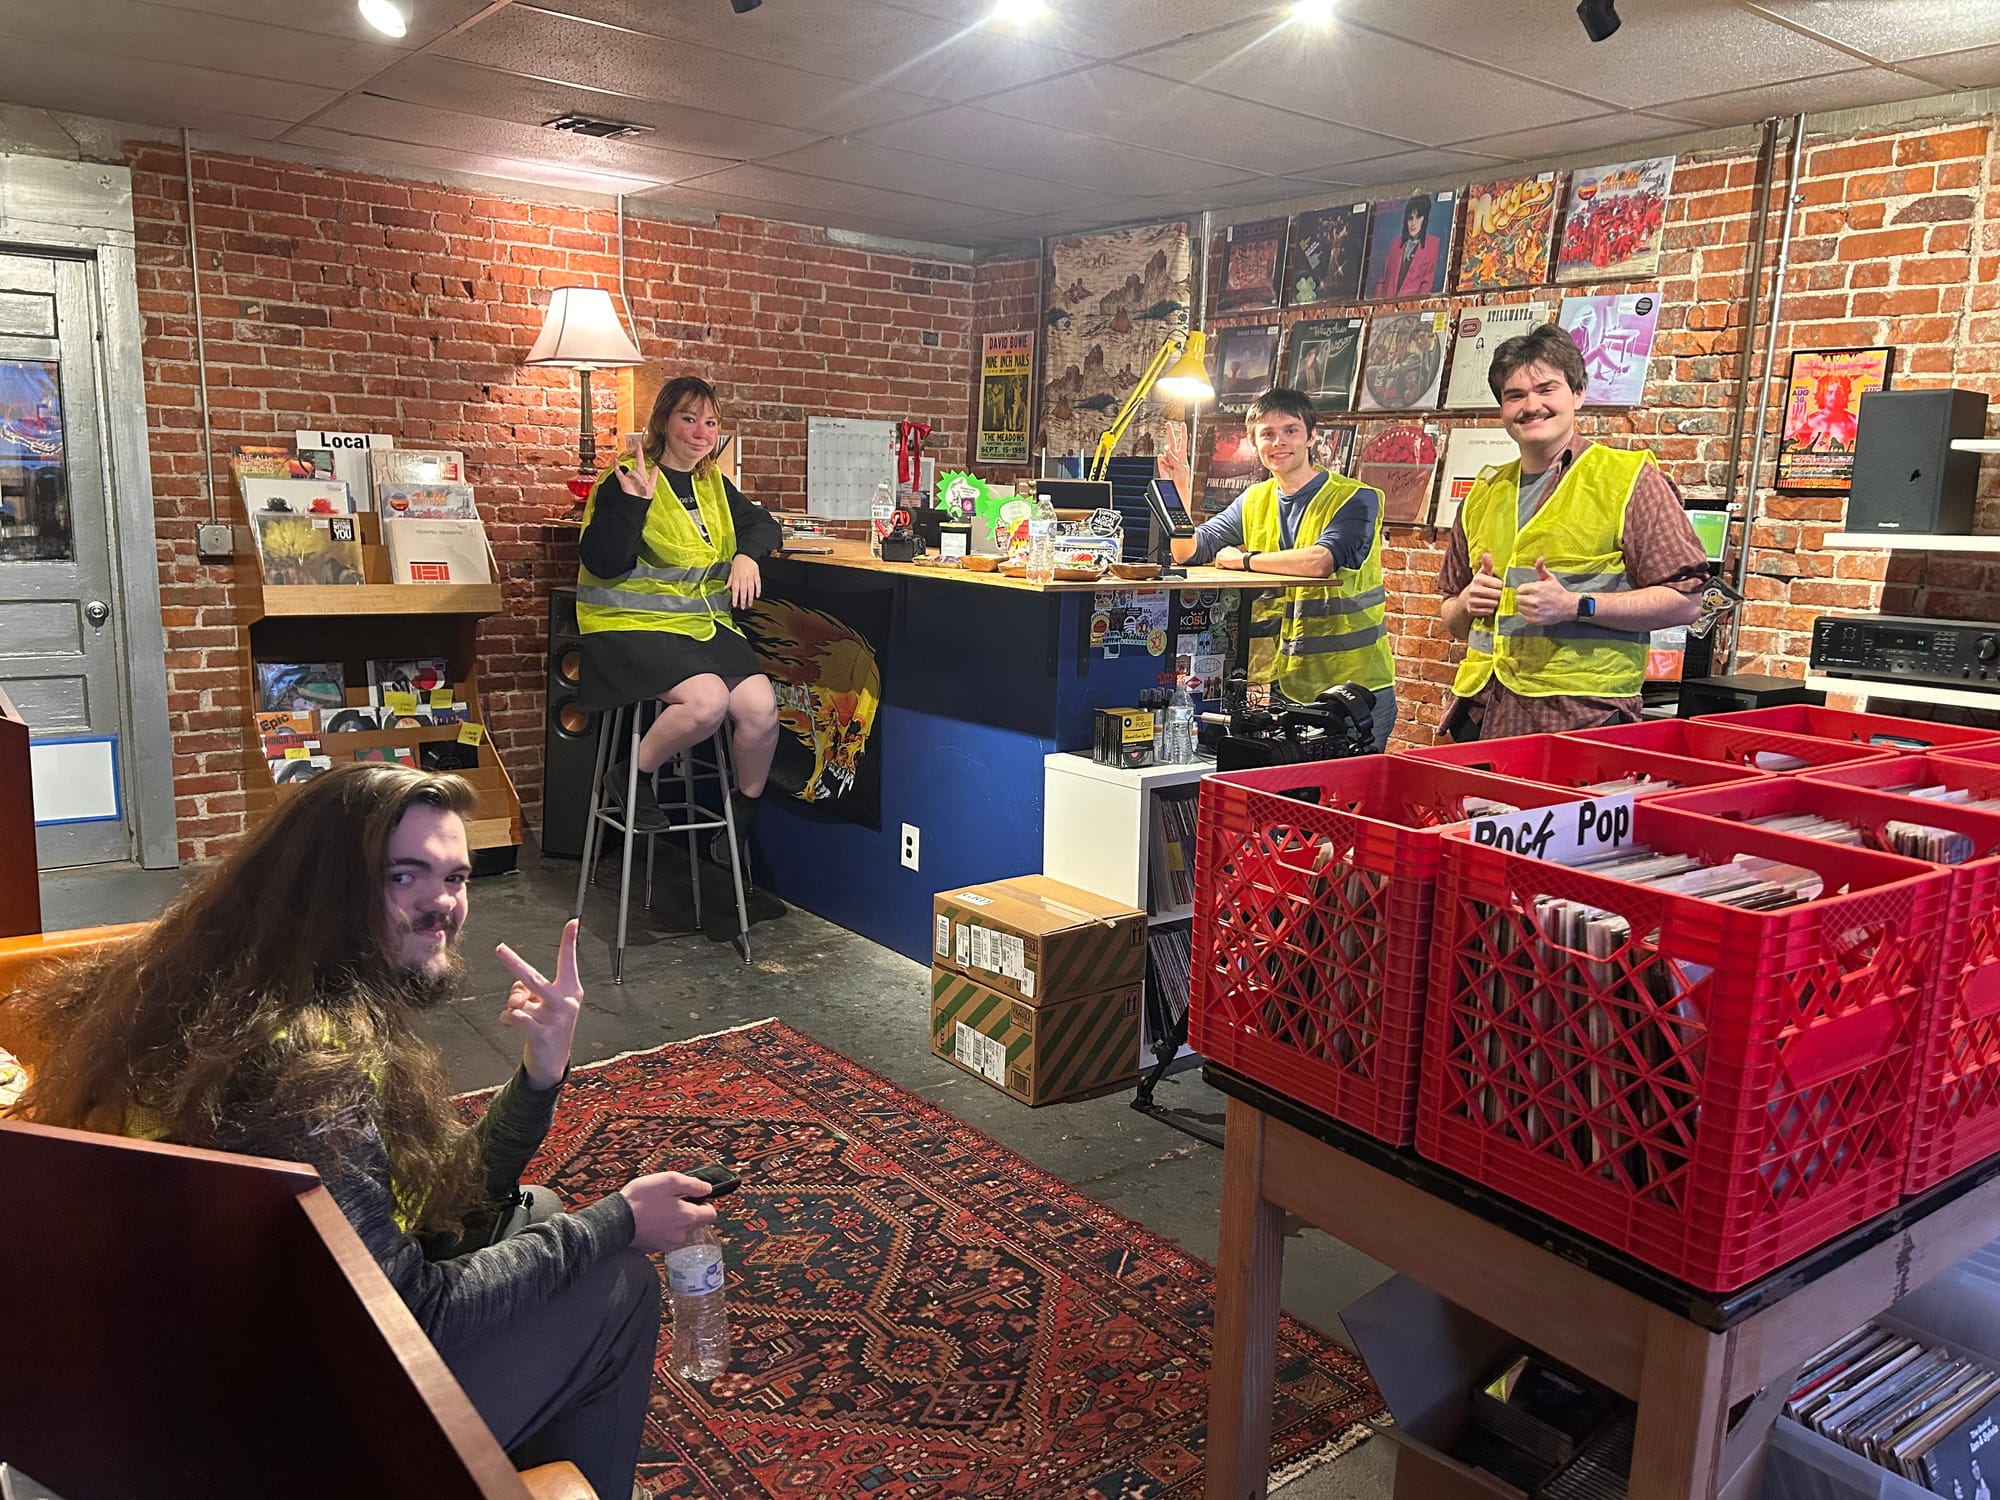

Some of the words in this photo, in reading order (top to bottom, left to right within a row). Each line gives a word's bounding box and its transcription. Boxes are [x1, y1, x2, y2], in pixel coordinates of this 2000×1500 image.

[1468, 179, 1552, 237] Nuggets
[989, 337, 1008, 350] DAVID
[1009, 335, 1027, 348] BOWIE
[985, 356, 998, 368] NINE
[1000, 355, 1013, 368] INCH
[1014, 354, 1030, 367] NAILS
[321, 432, 370, 449] Local
[984, 433, 995, 441] THE
[997, 433, 1024, 441] MEADOWS
[239, 453, 254, 461] THE
[240, 466, 274, 474] REJECTS
[1206, 477, 1219, 487] PINK
[1220, 478, 1236, 488] FLOYD
[1236, 479, 1243, 488] AT
[333, 529, 352, 539] YOU
[1180, 614, 1207, 626] KOSU
[260, 713, 290, 732] Epic
[266, 735, 289, 745] MINOR
[292, 734, 320, 744] THREAT
[1577, 801, 1629, 847] Pop
